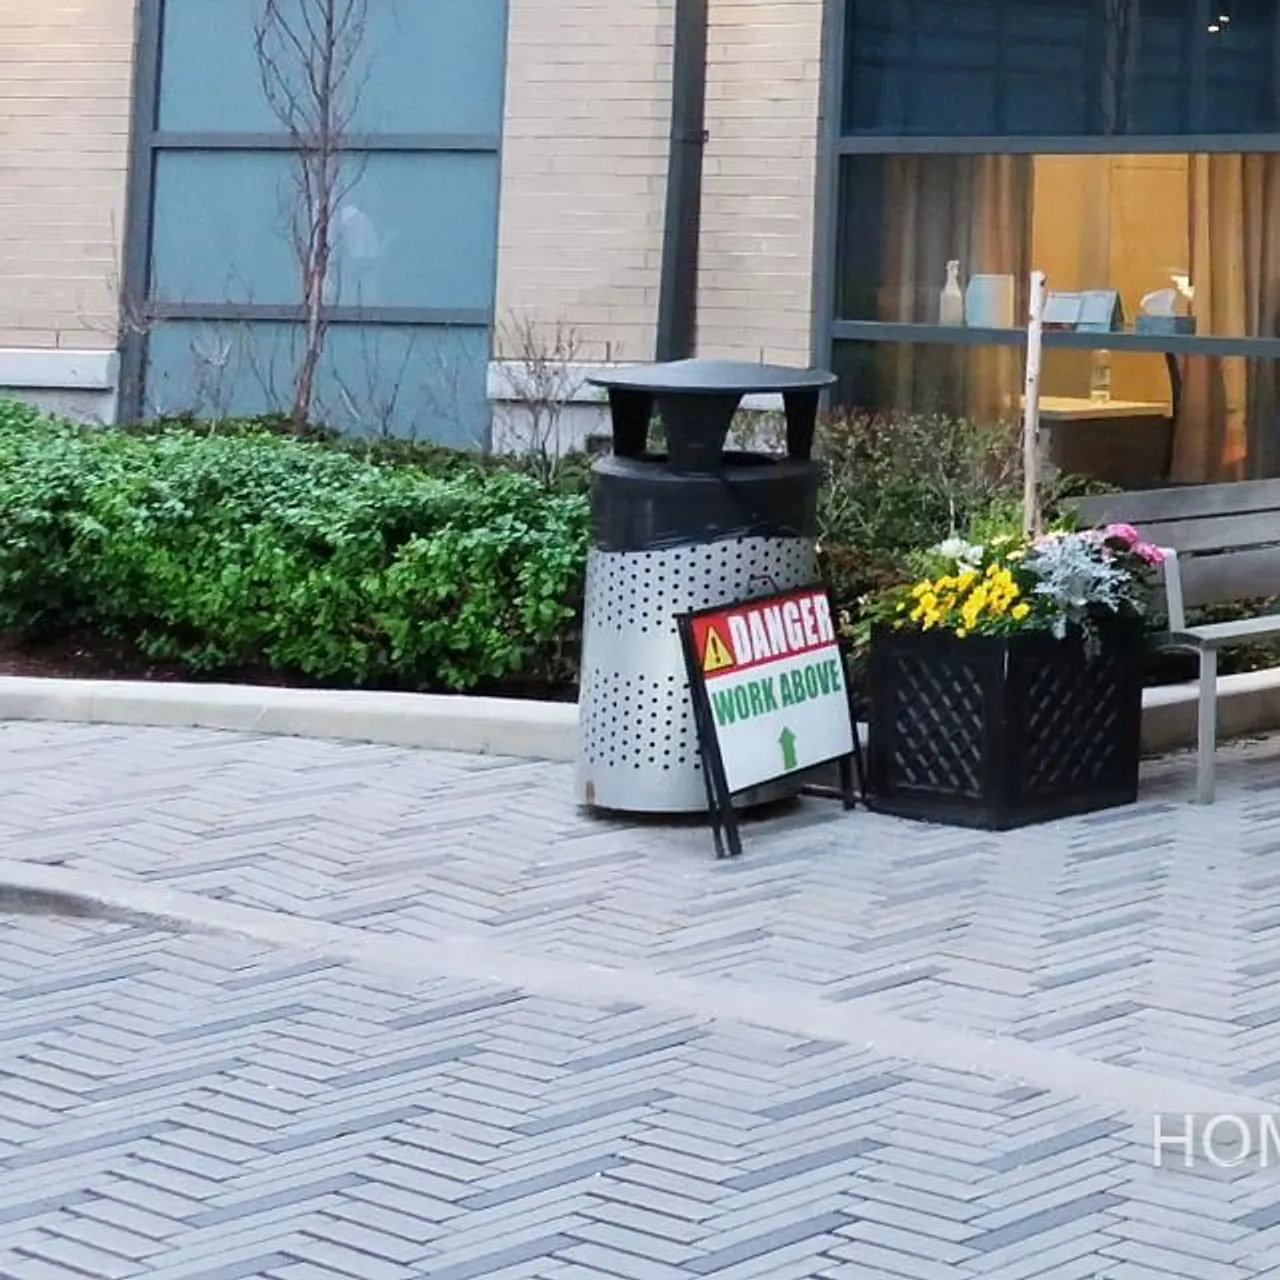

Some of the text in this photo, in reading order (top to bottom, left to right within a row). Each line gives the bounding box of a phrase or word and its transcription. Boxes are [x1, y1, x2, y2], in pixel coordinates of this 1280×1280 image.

[727, 593, 835, 665] DANGER
[711, 659, 842, 726] WORK ABOVE
